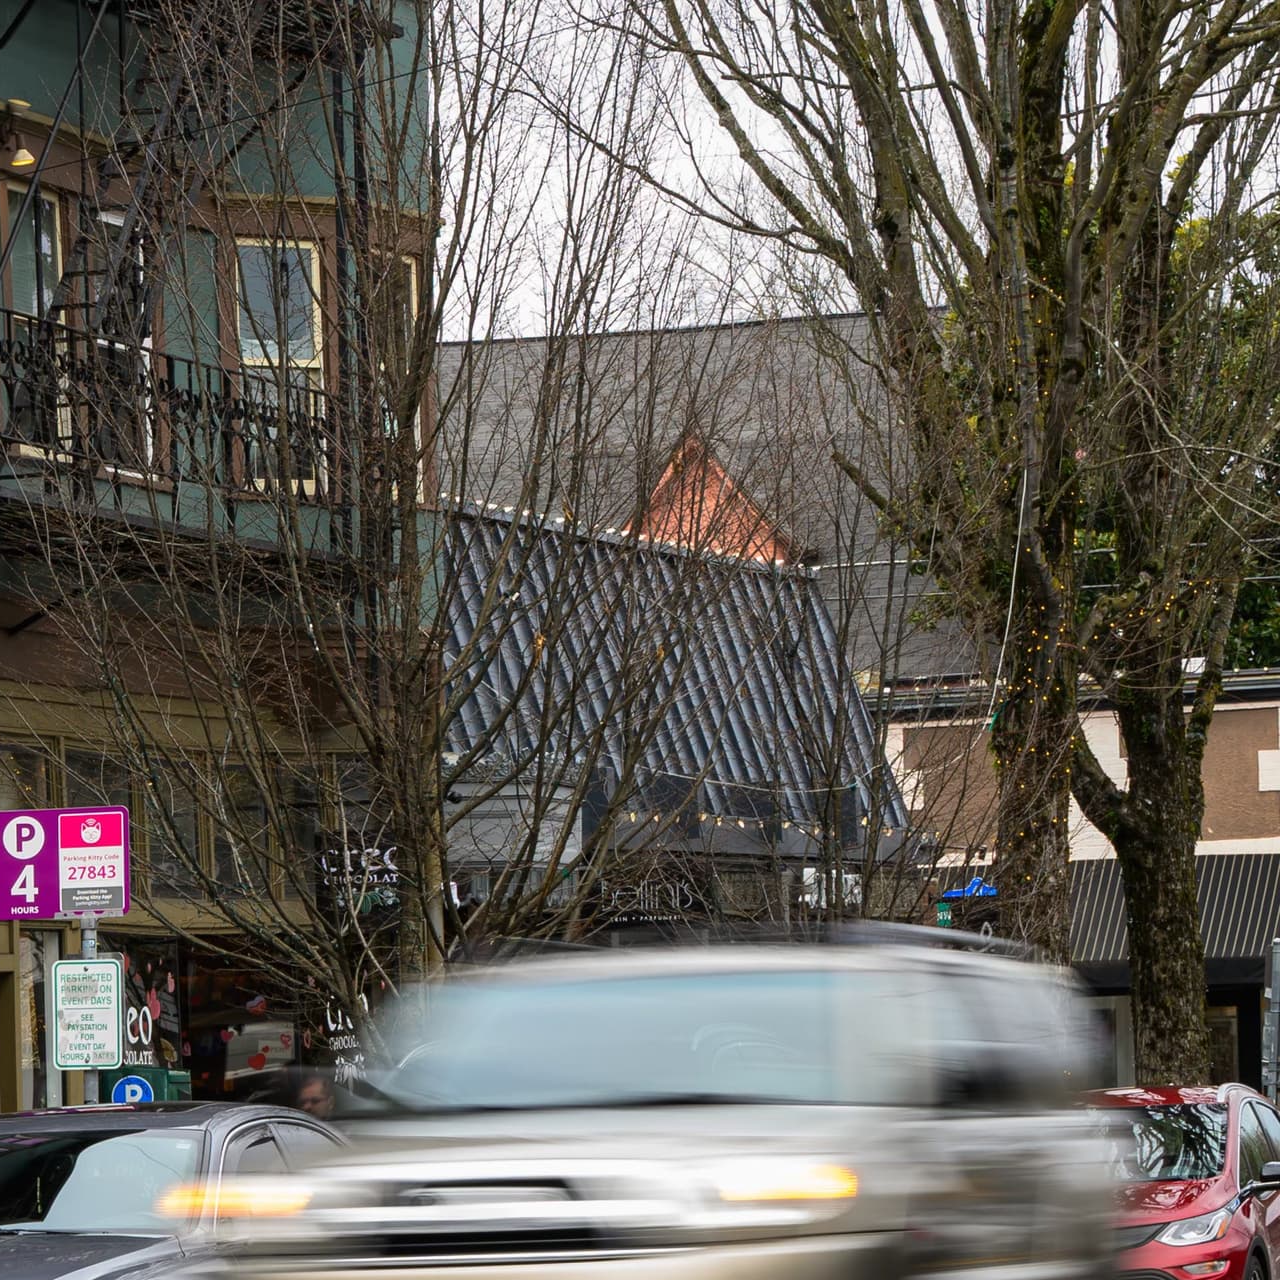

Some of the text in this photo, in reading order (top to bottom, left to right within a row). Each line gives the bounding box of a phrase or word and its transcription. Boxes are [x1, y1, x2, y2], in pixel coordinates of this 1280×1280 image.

[16, 823, 35, 852] P
[68, 865, 116, 880] 27843
[11, 864, 39, 903] 4
[11, 906, 39, 914] HOURS
[60, 973, 112, 983] RESTRICTED
[99, 985, 112, 993] ON
[61, 996, 113, 1006] EVENT DAYS
[67, 1023, 108, 1031] PAYSTATION
[80, 1033, 95, 1041] FOR
[69, 1043, 91, 1051] EVENT
